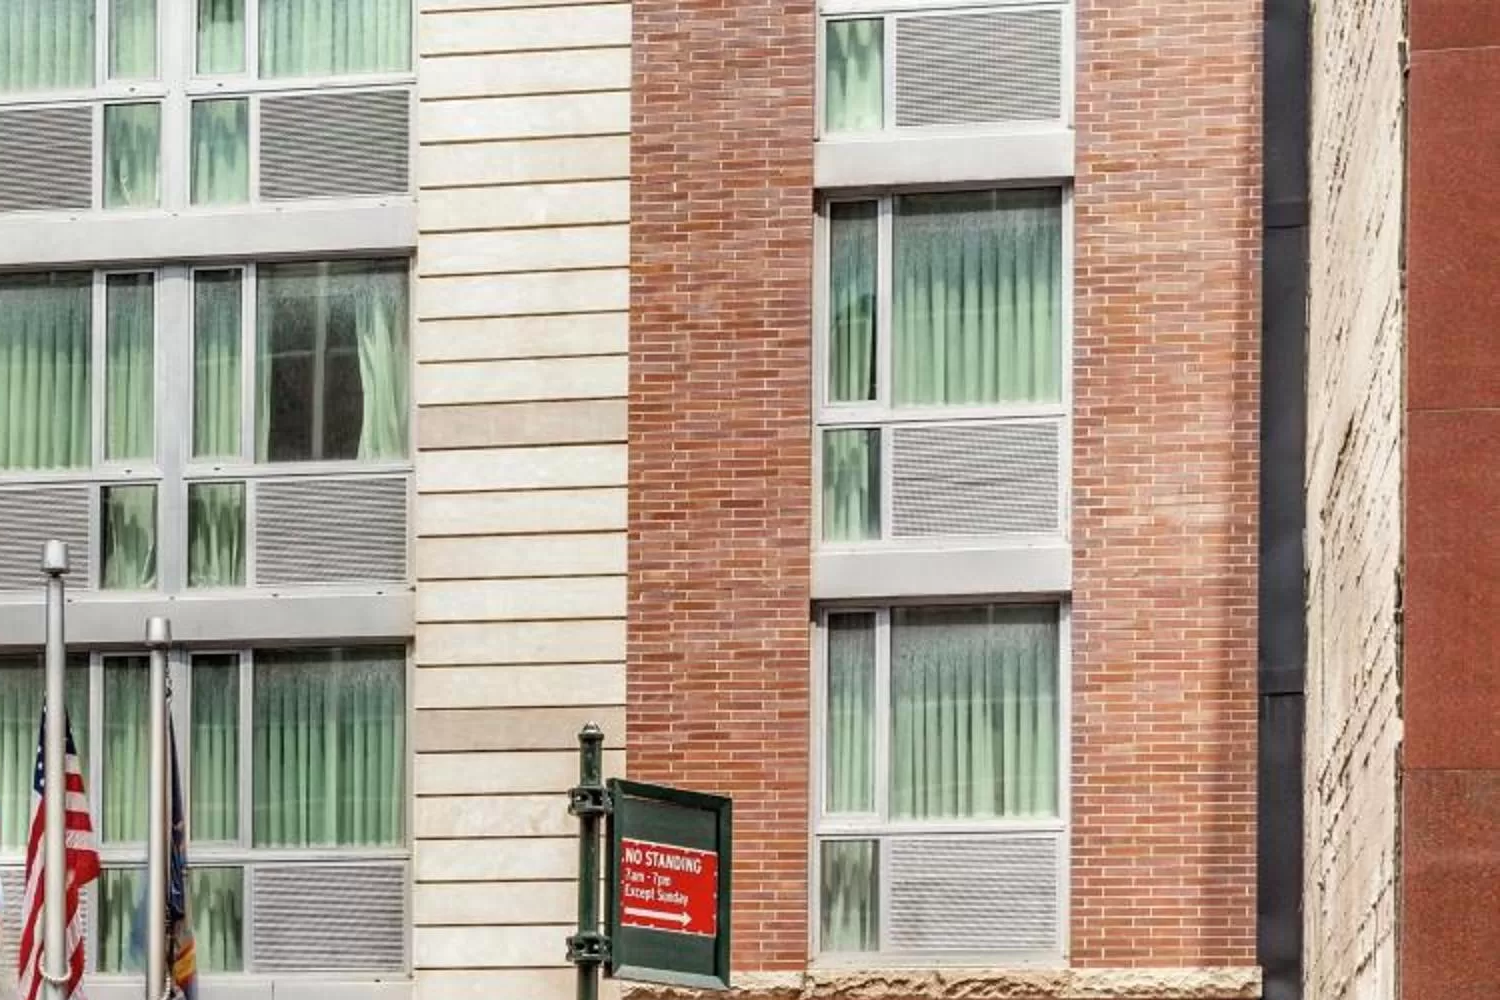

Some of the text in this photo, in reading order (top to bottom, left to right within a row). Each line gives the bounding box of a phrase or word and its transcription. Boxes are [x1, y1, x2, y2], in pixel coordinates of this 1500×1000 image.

[625, 848, 702, 875] NO STANDING
[625, 867, 645, 883] 7am
[652, 872, 673, 887] 7pm
[625, 883, 689, 908] Except Sunday
